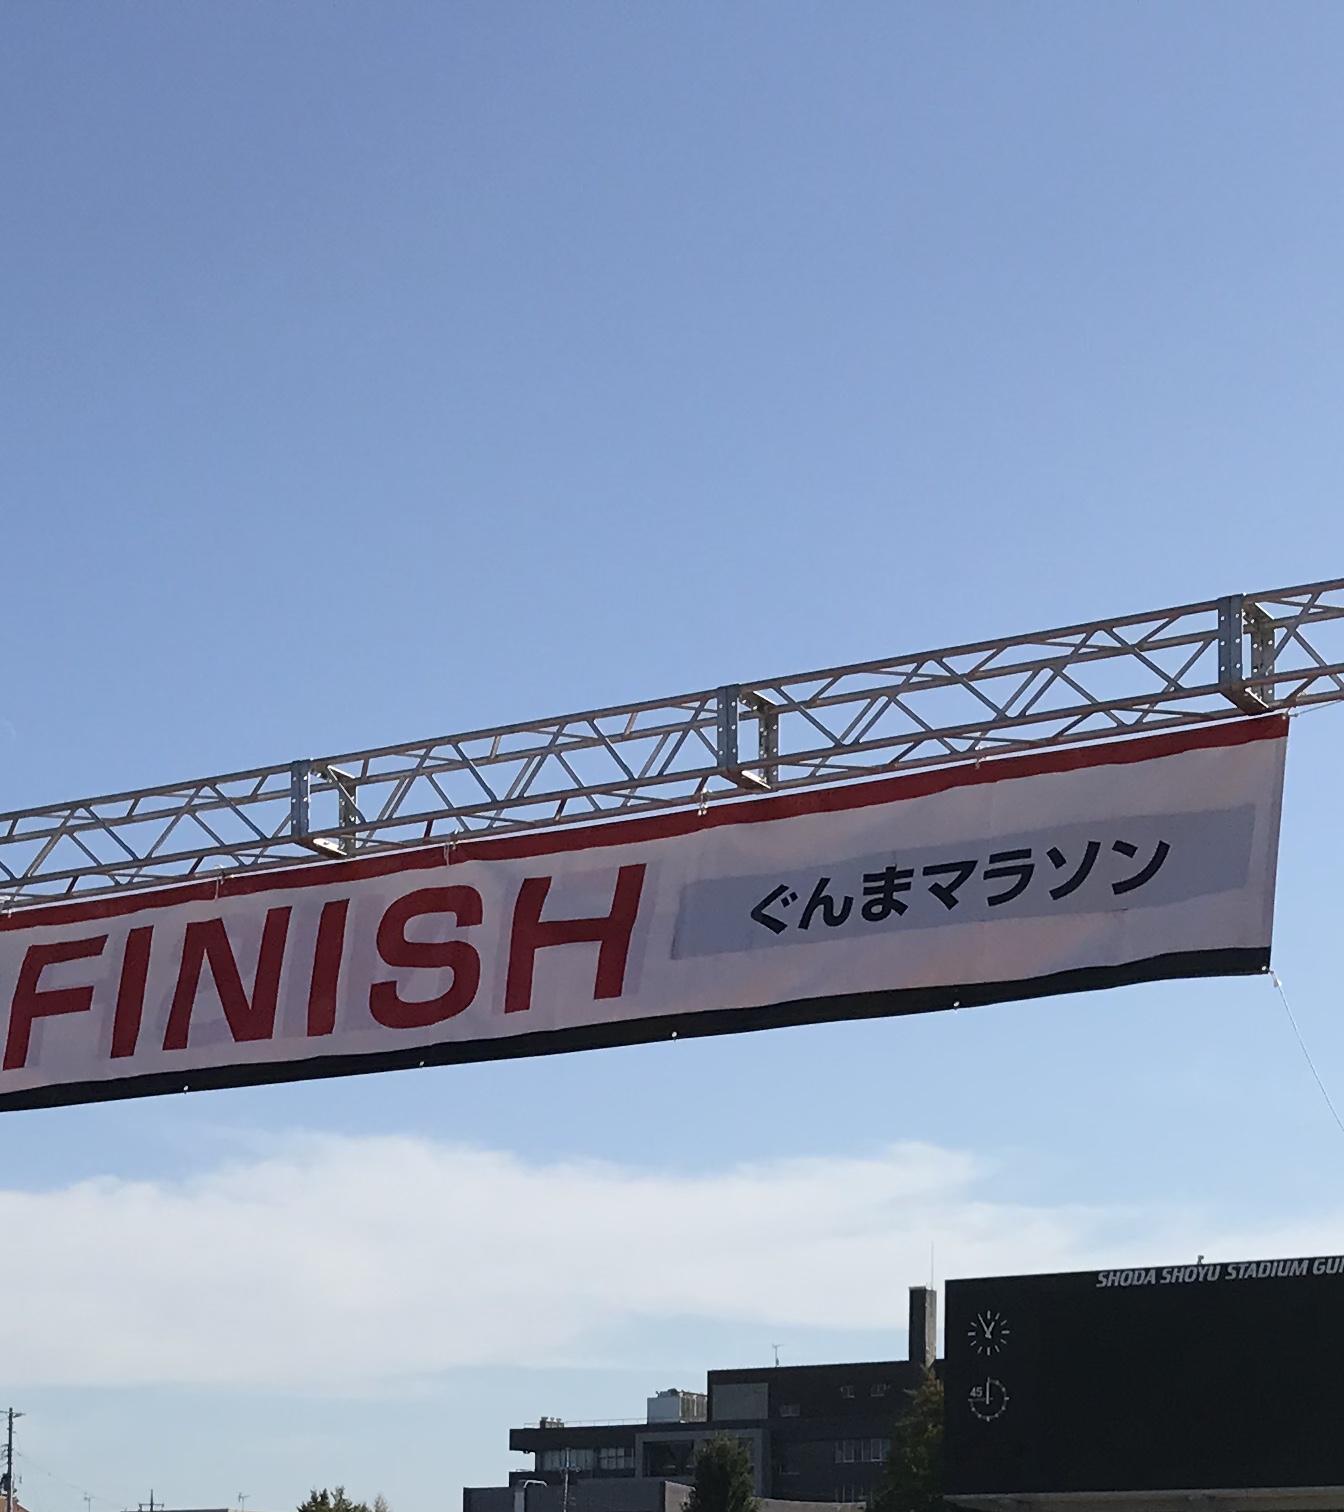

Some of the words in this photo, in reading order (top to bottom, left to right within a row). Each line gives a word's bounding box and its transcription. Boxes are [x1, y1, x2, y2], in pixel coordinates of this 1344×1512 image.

[749, 838, 1172, 936] ぐんまマラソン
[2, 863, 647, 1071] FINISH
[1096, 1269, 1156, 1287] SHODA
[1159, 1266, 1221, 1284] SHOYU
[1224, 1259, 1309, 1280] STADIUM
[969, 1386, 983, 1397] 45
